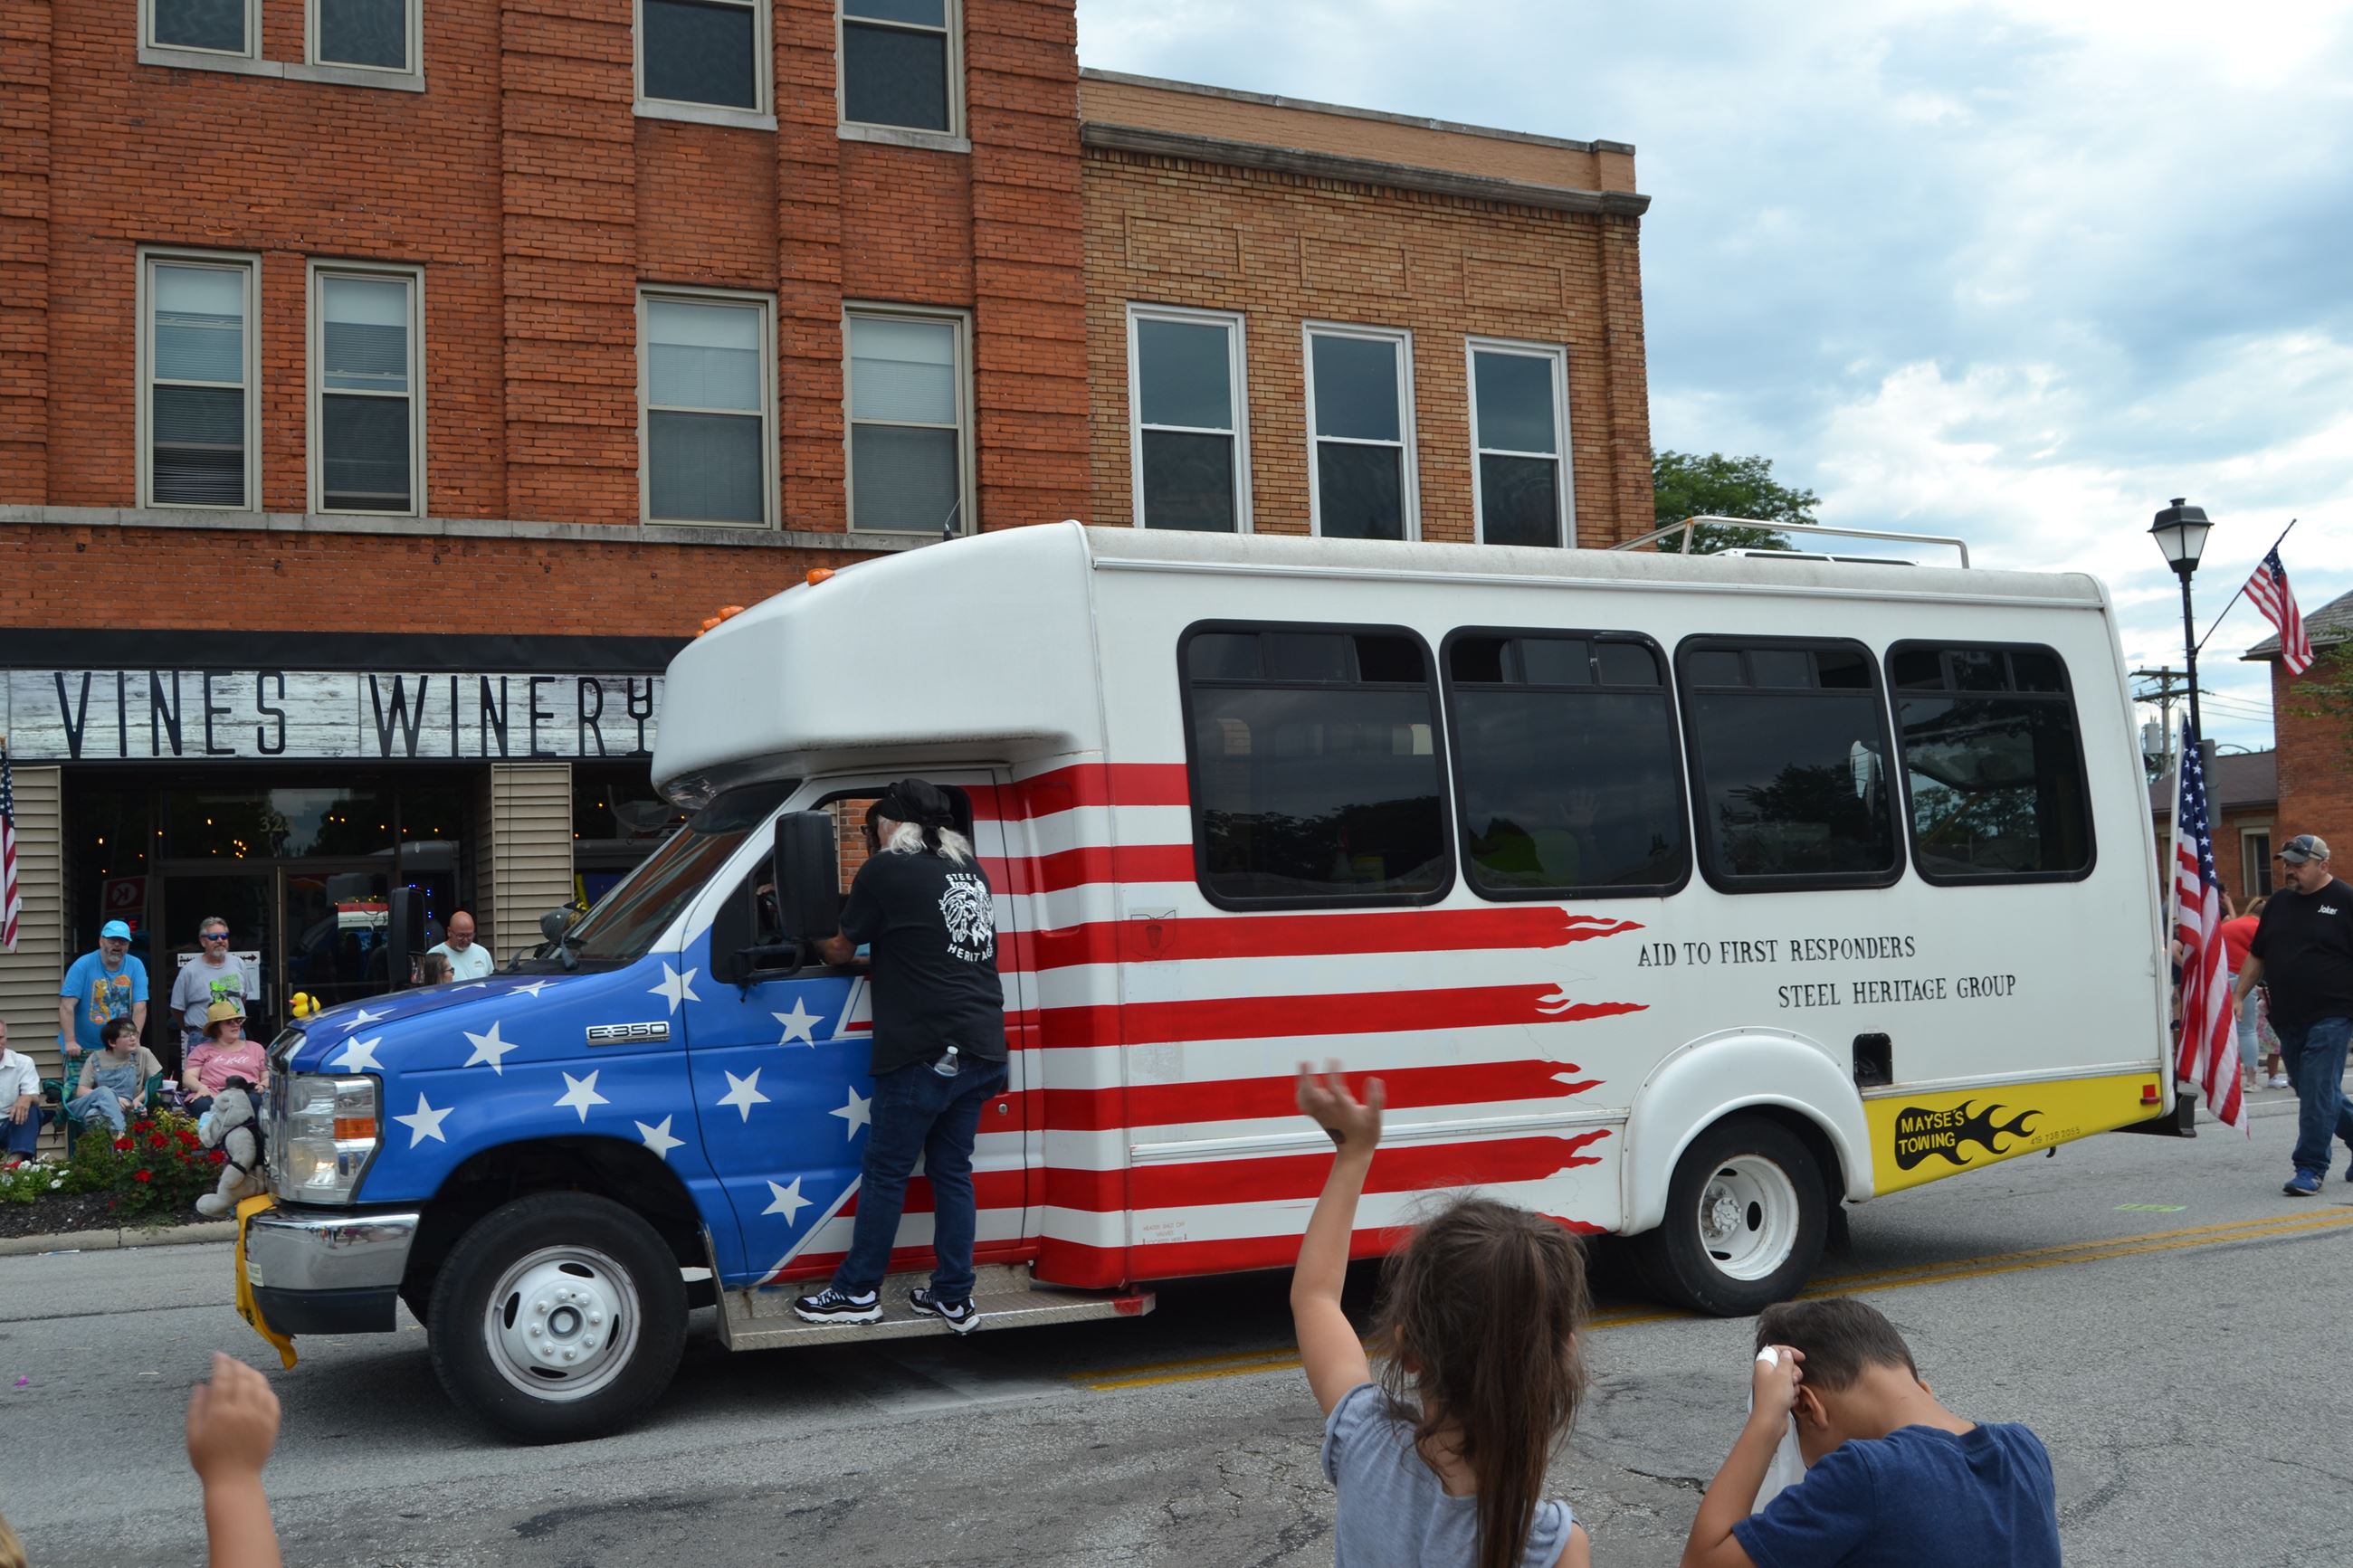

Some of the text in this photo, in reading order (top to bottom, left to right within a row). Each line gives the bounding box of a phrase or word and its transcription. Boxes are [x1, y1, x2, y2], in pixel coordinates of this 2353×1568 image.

[54, 670, 653, 758] VINES WINERY
[945, 873, 979, 883] STEEL
[2317, 904, 2339, 916] Joker
[947, 943, 994, 963] HERITAG
[1637, 936, 1916, 966] AID TO FIRST RESPONDERS
[1777, 974, 2016, 1009] STEEL HERITAGE GROUP
[1900, 1109, 1965, 1134] MAYSE'S
[1898, 1132, 1956, 1155] TOWING
